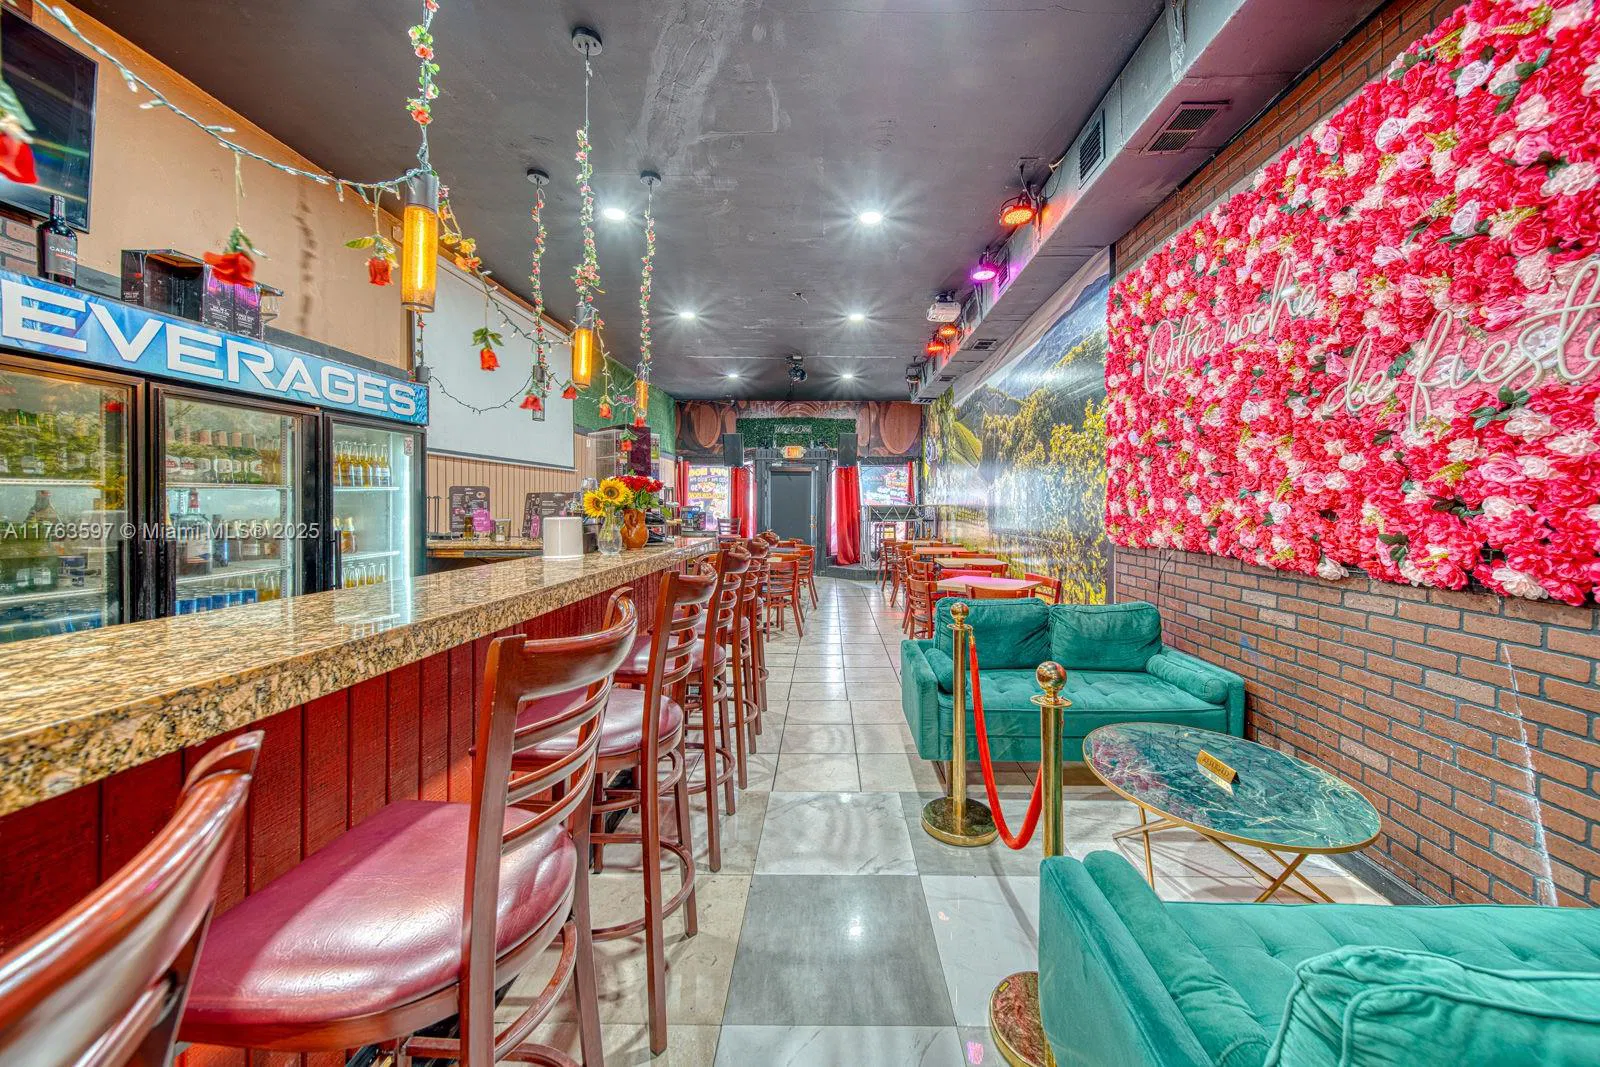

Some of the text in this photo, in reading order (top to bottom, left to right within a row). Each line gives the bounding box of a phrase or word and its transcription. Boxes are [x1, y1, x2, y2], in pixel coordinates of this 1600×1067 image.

[1224, 257, 1317, 337] noche
[1, 278, 416, 416] EVERAGES
[1323, 336, 1398, 413] de
